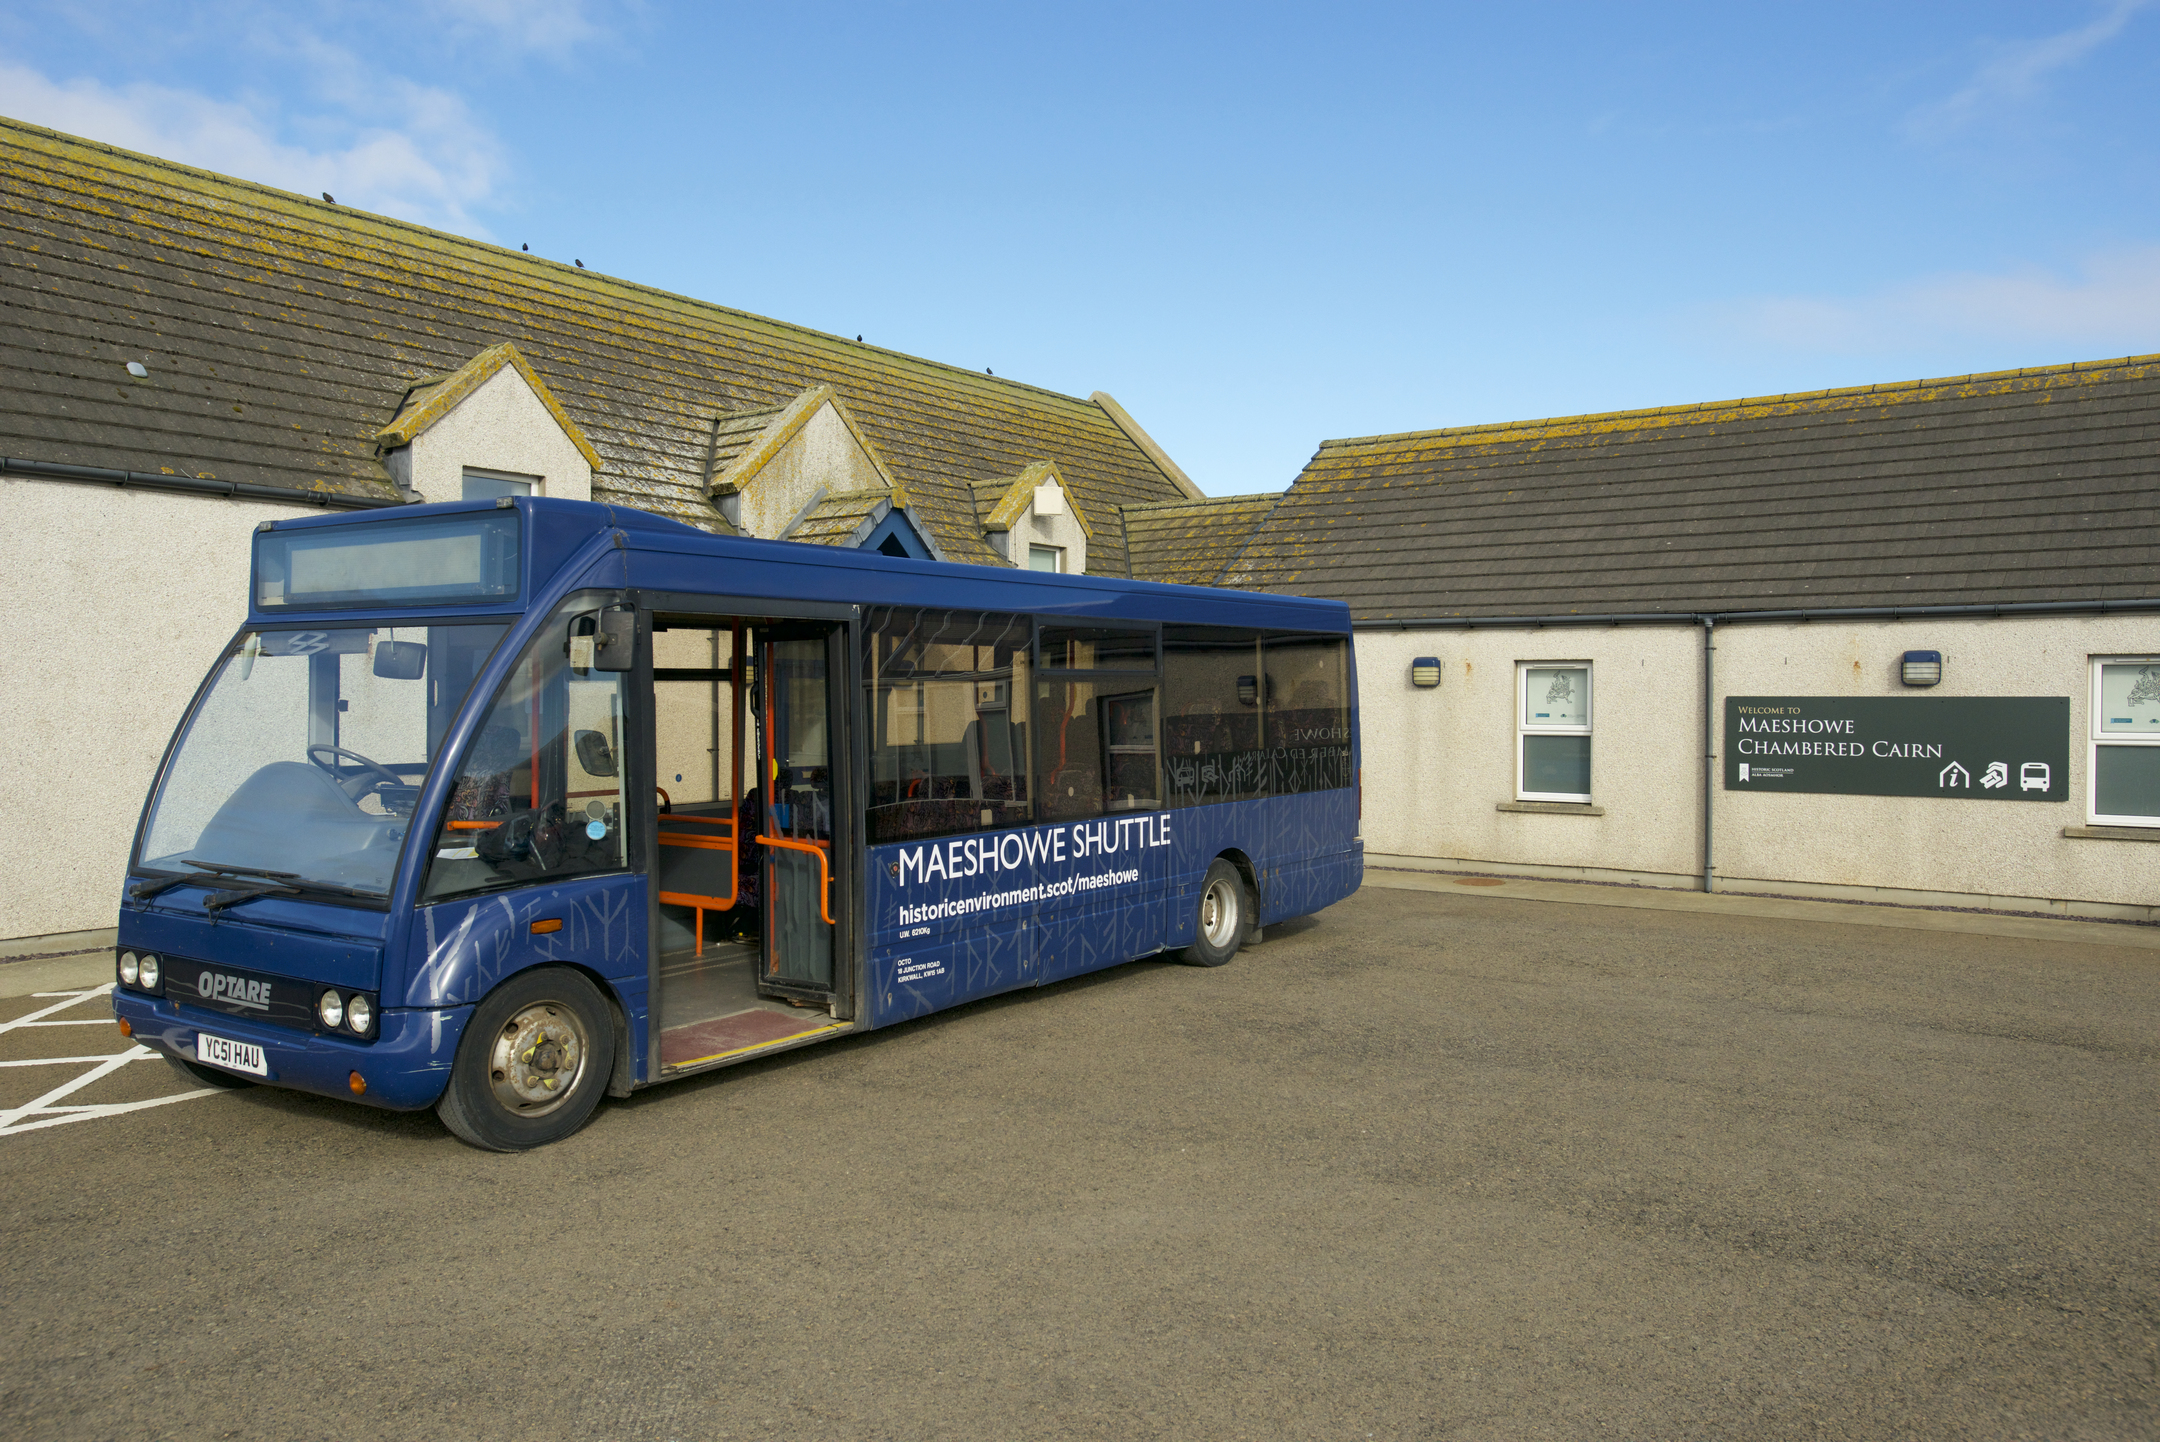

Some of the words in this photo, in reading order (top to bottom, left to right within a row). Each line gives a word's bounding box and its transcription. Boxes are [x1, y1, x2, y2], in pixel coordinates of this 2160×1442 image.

[1738, 706, 1785, 715] WELCOME
[1787, 706, 1801, 715] TO
[1738, 717, 1855, 734] MAESHOWE
[1738, 739, 1865, 757] CHAMBERED
[1872, 741, 1942, 759] CAIRN
[900, 827, 1066, 887] MAESHOWE
[1073, 814, 1171, 858] SHUTTLE
[899, 868, 1139, 925] historicenvironment.scot/maeshowe
[897, 957, 912, 967] OCTO
[903, 963, 927, 974] JUNCTION
[926, 960, 941, 969] ROAD
[198, 971, 272, 1005] OPTARE
[206, 1037, 231, 1062] YC51
[234, 1044, 260, 1069] HAU
